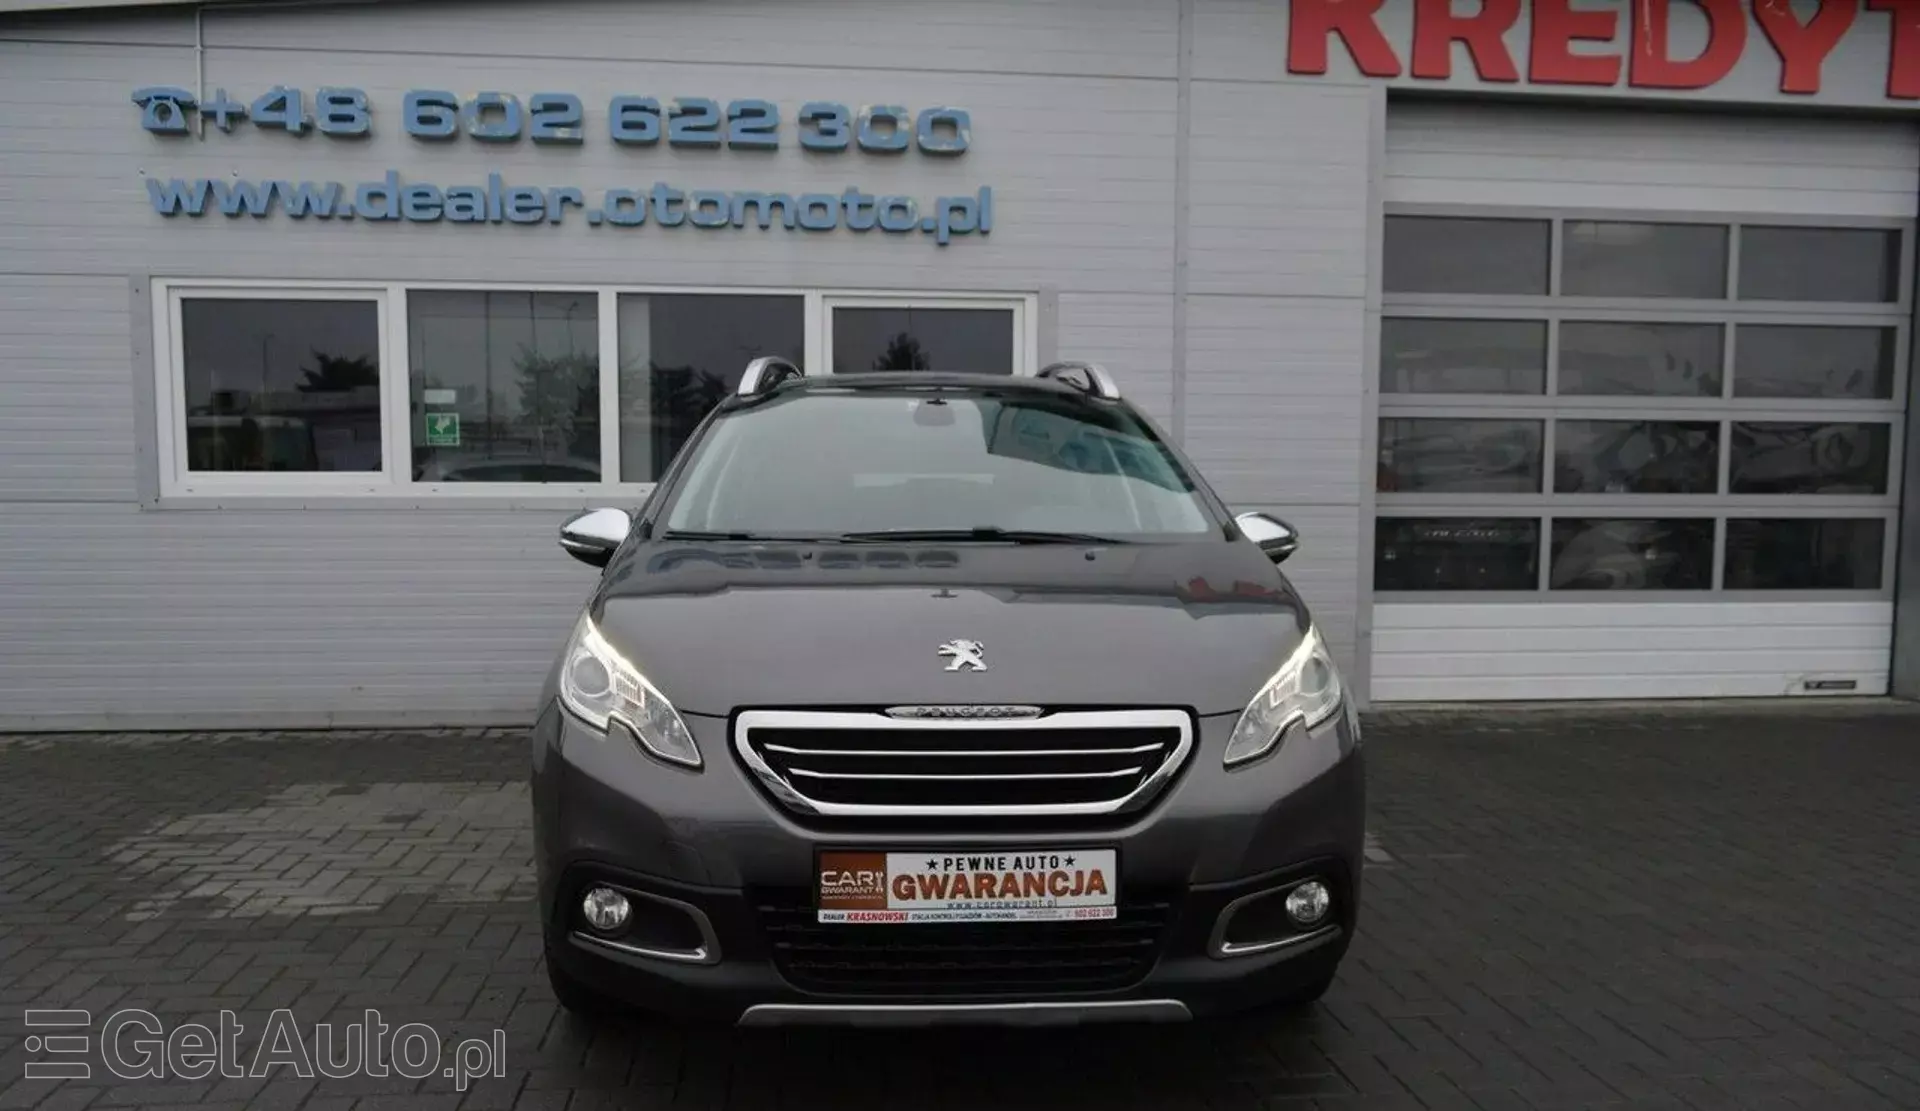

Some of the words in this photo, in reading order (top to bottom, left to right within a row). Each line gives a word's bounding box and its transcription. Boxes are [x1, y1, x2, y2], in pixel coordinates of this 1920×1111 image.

[201, 84, 371, 137] +48
[402, 88, 584, 145] 602
[608, 94, 779, 151] 622
[798, 101, 972, 156] 300
[146, 170, 992, 246] www.dealer.otomoto.pl
[943, 856, 1006, 871] PEWNE
[1013, 855, 1059, 870] AUTO
[821, 870, 874, 887] CAR
[892, 869, 1108, 901] GWARANCJA
[847, 911, 908, 921] KRASNOWSKI
